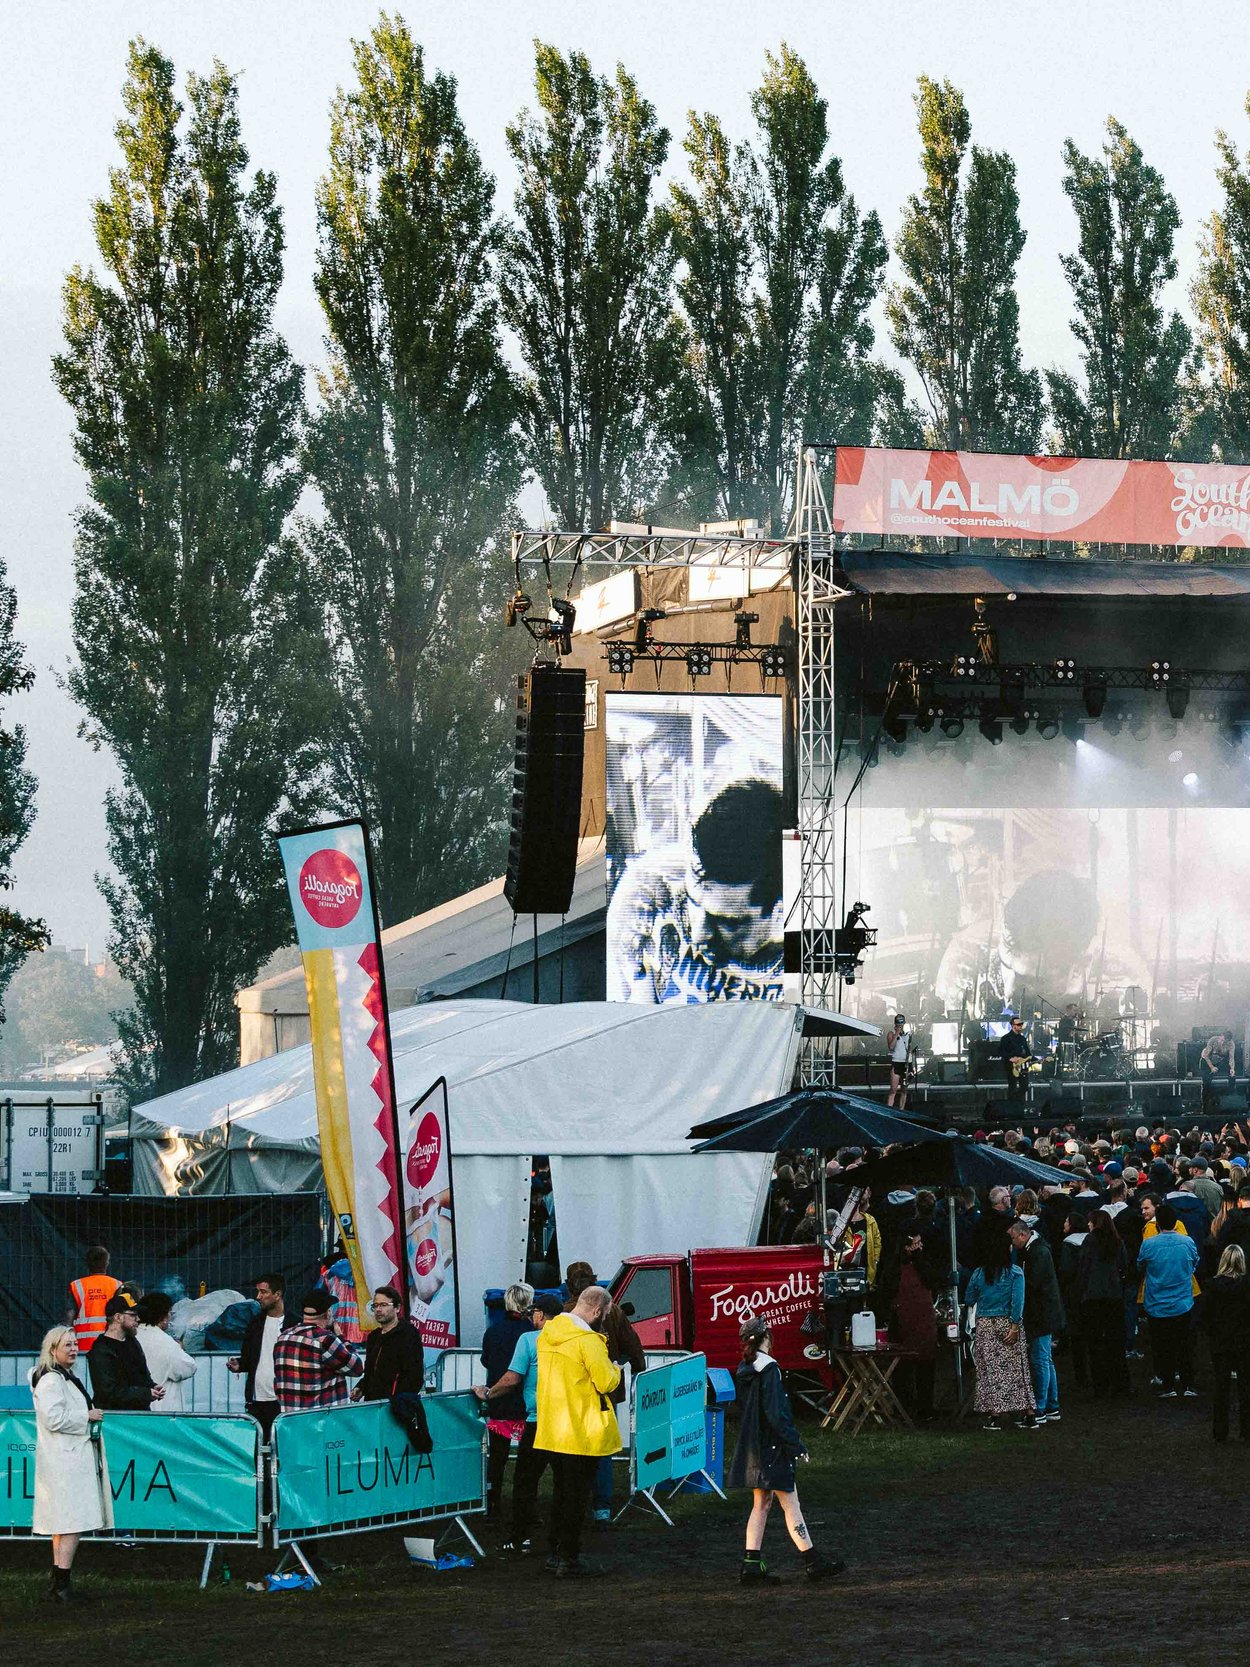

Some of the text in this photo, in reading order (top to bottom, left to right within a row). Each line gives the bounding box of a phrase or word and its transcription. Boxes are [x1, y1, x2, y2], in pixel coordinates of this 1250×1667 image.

[889, 478, 1080, 517] MALMÖ
[890, 513, 1030, 529] @southoceanfestival
[28, 1127, 91, 1138] CPIU 000012 7
[53, 1143, 72, 1153] 22R1
[710, 1271, 815, 1324] Fogarolli
[762, 1300, 813, 1319] GREAT COFFEE
[764, 1315, 792, 1329] WHERE
[642, 1388, 666, 1410] RÖKRUTA
[7, 1443, 37, 1451] IQOS
[325, 1440, 345, 1450] IQOS
[326, 1444, 435, 1497] ILUMA
[7, 1456, 178, 1503] ILMA
